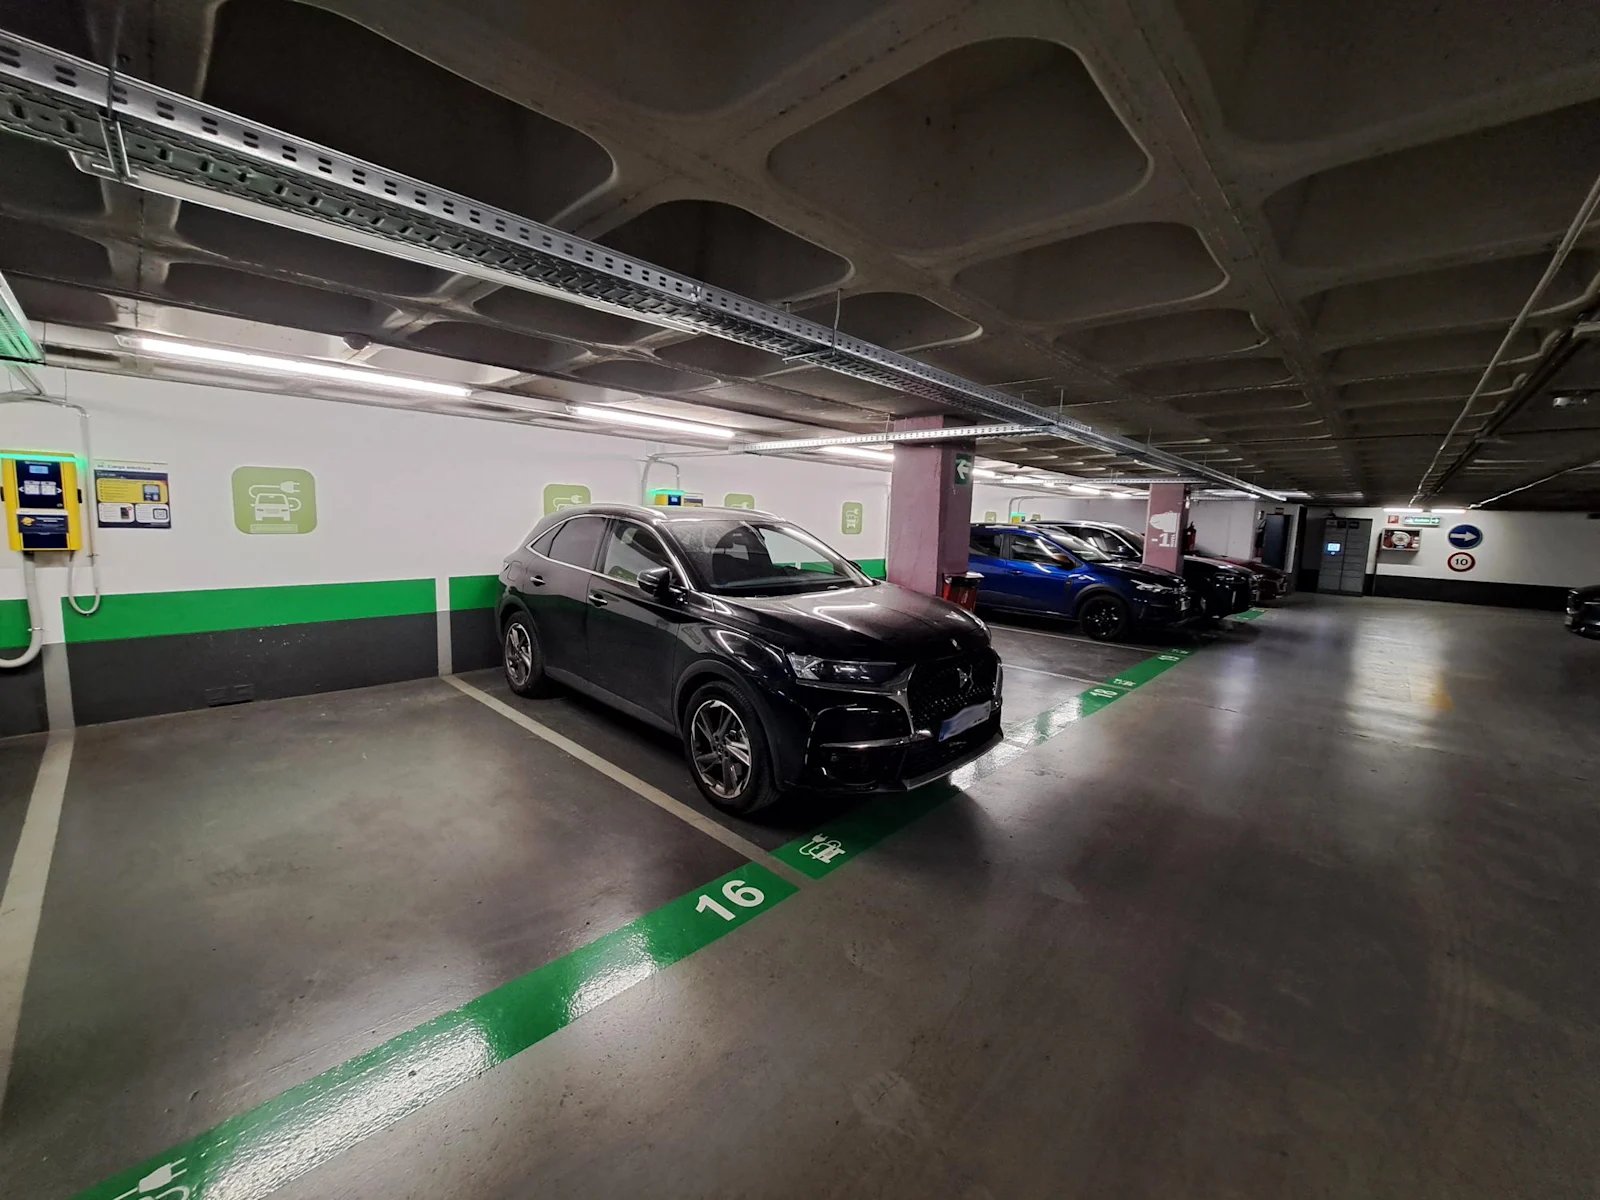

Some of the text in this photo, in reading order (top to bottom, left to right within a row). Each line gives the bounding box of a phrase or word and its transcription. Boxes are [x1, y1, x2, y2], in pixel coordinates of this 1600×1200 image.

[1455, 558, 1469, 566] 10
[1089, 688, 1118, 699] 18
[695, 879, 765, 922] 16
